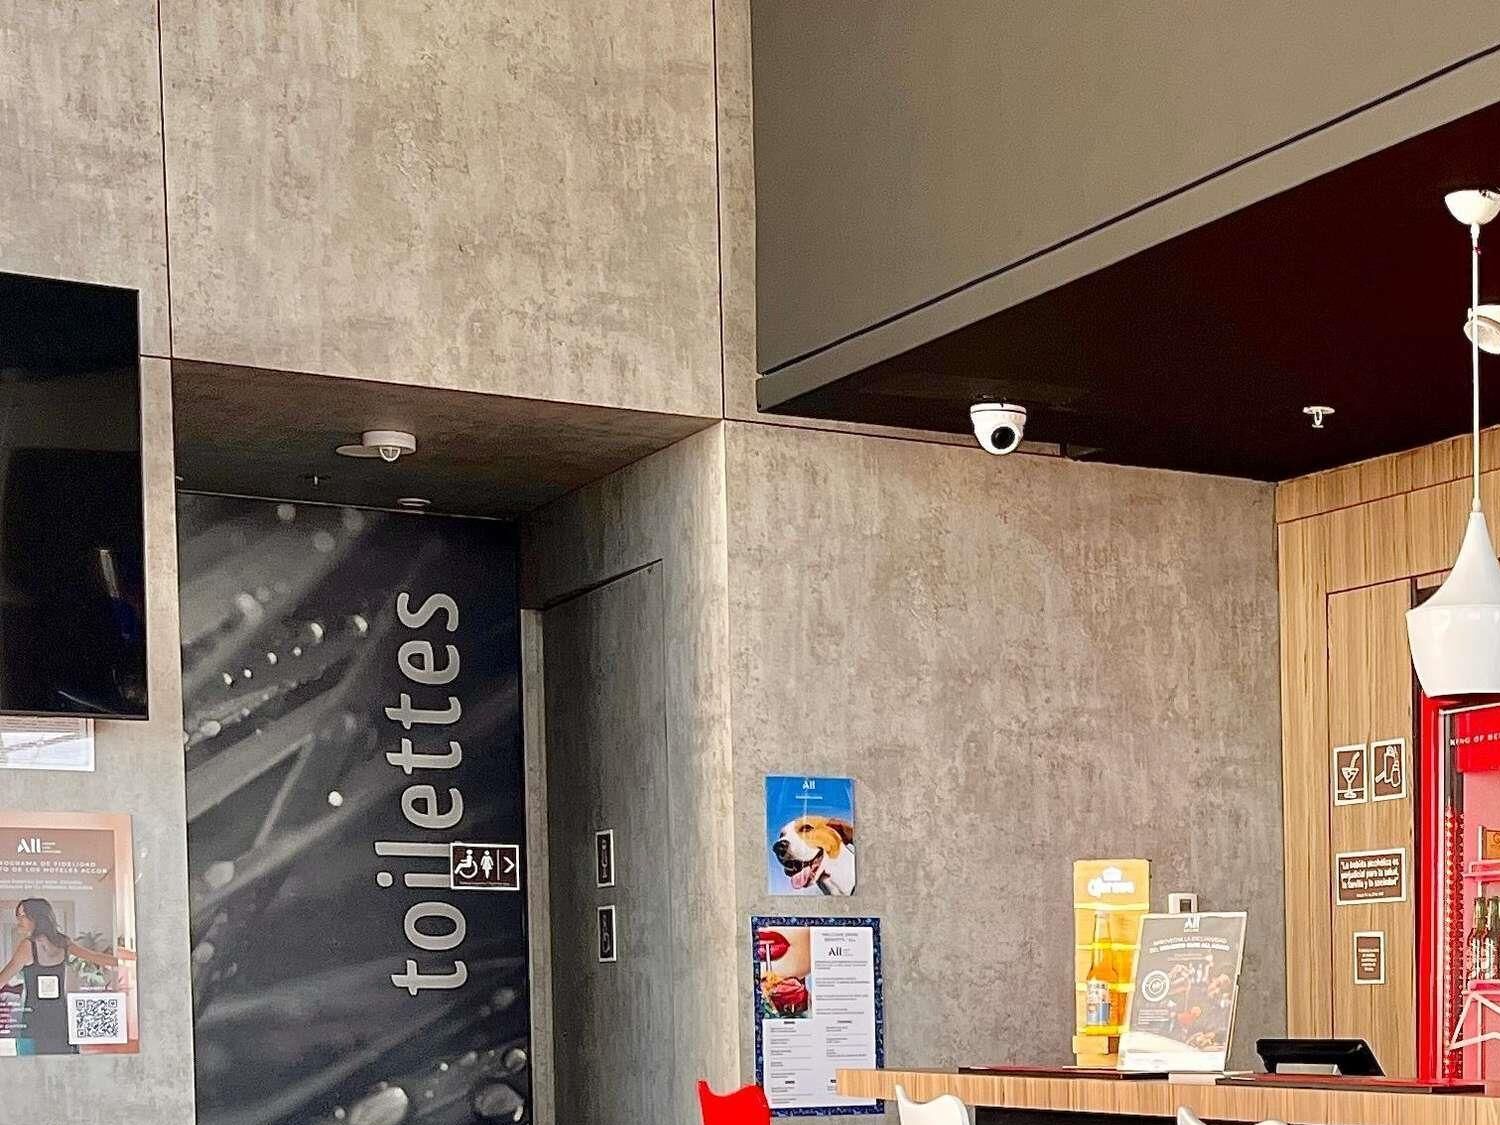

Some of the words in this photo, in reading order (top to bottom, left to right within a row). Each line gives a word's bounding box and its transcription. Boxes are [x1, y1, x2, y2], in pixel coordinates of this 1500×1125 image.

[1473, 735, 1485, 743] OF
[375, 592, 468, 997] toilettes
[17, 838, 41, 853] All
